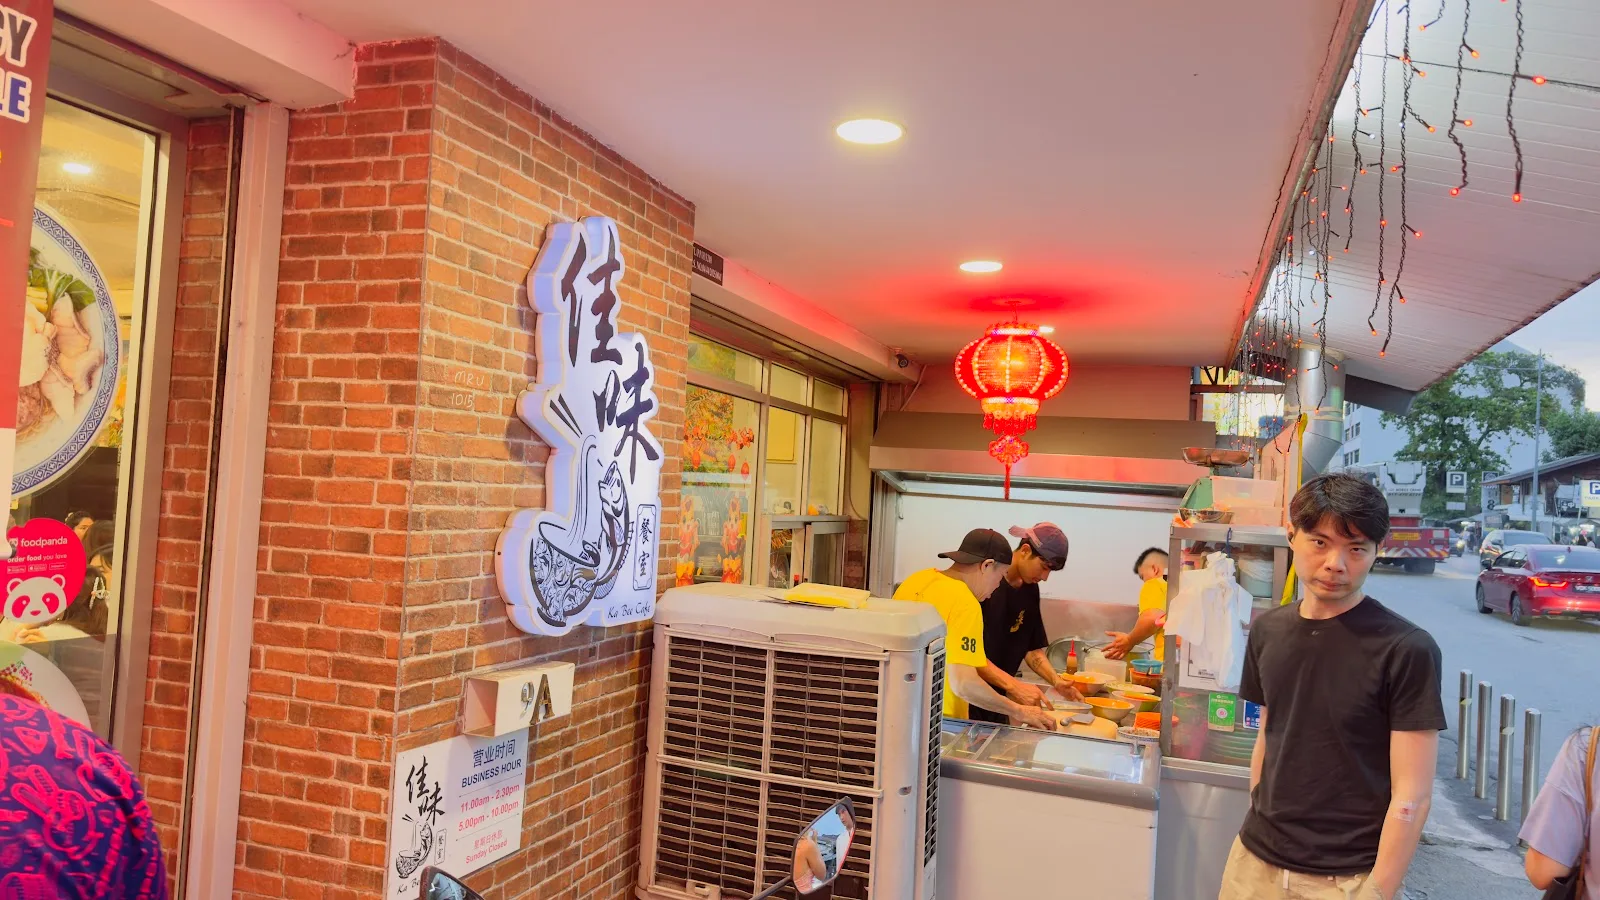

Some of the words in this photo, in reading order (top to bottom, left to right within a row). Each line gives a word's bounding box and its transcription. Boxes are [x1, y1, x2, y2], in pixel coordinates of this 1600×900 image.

[0, 74, 29, 120] E
[560, 225, 660, 484] 佳味
[1452, 473, 1463, 486] P
[1591, 482, 1600, 494] P
[20, 536, 68, 548] foodpanda
[26, 554, 42, 562] food
[608, 606, 618, 619] Ka
[621, 604, 633, 617] Bee
[635, 601, 651, 616] Cafe
[961, 636, 976, 653] 38
[520, 674, 556, 725] 9A
[473, 739, 516, 768] 营业时间
[462, 766, 500, 788] BUSINESS
[501, 758, 522, 774] HOUR
[405, 755, 446, 826] 佳味
[460, 795, 490, 813] 11.00am
[495, 784, 520, 800] 2.30pm
[458, 814, 485, 832] 5.00pm
[491, 800, 519, 818] 10.00pm
[466, 849, 488, 864] Sunday
[488, 838, 508, 853] Closed
[411, 878, 420, 888] Be
